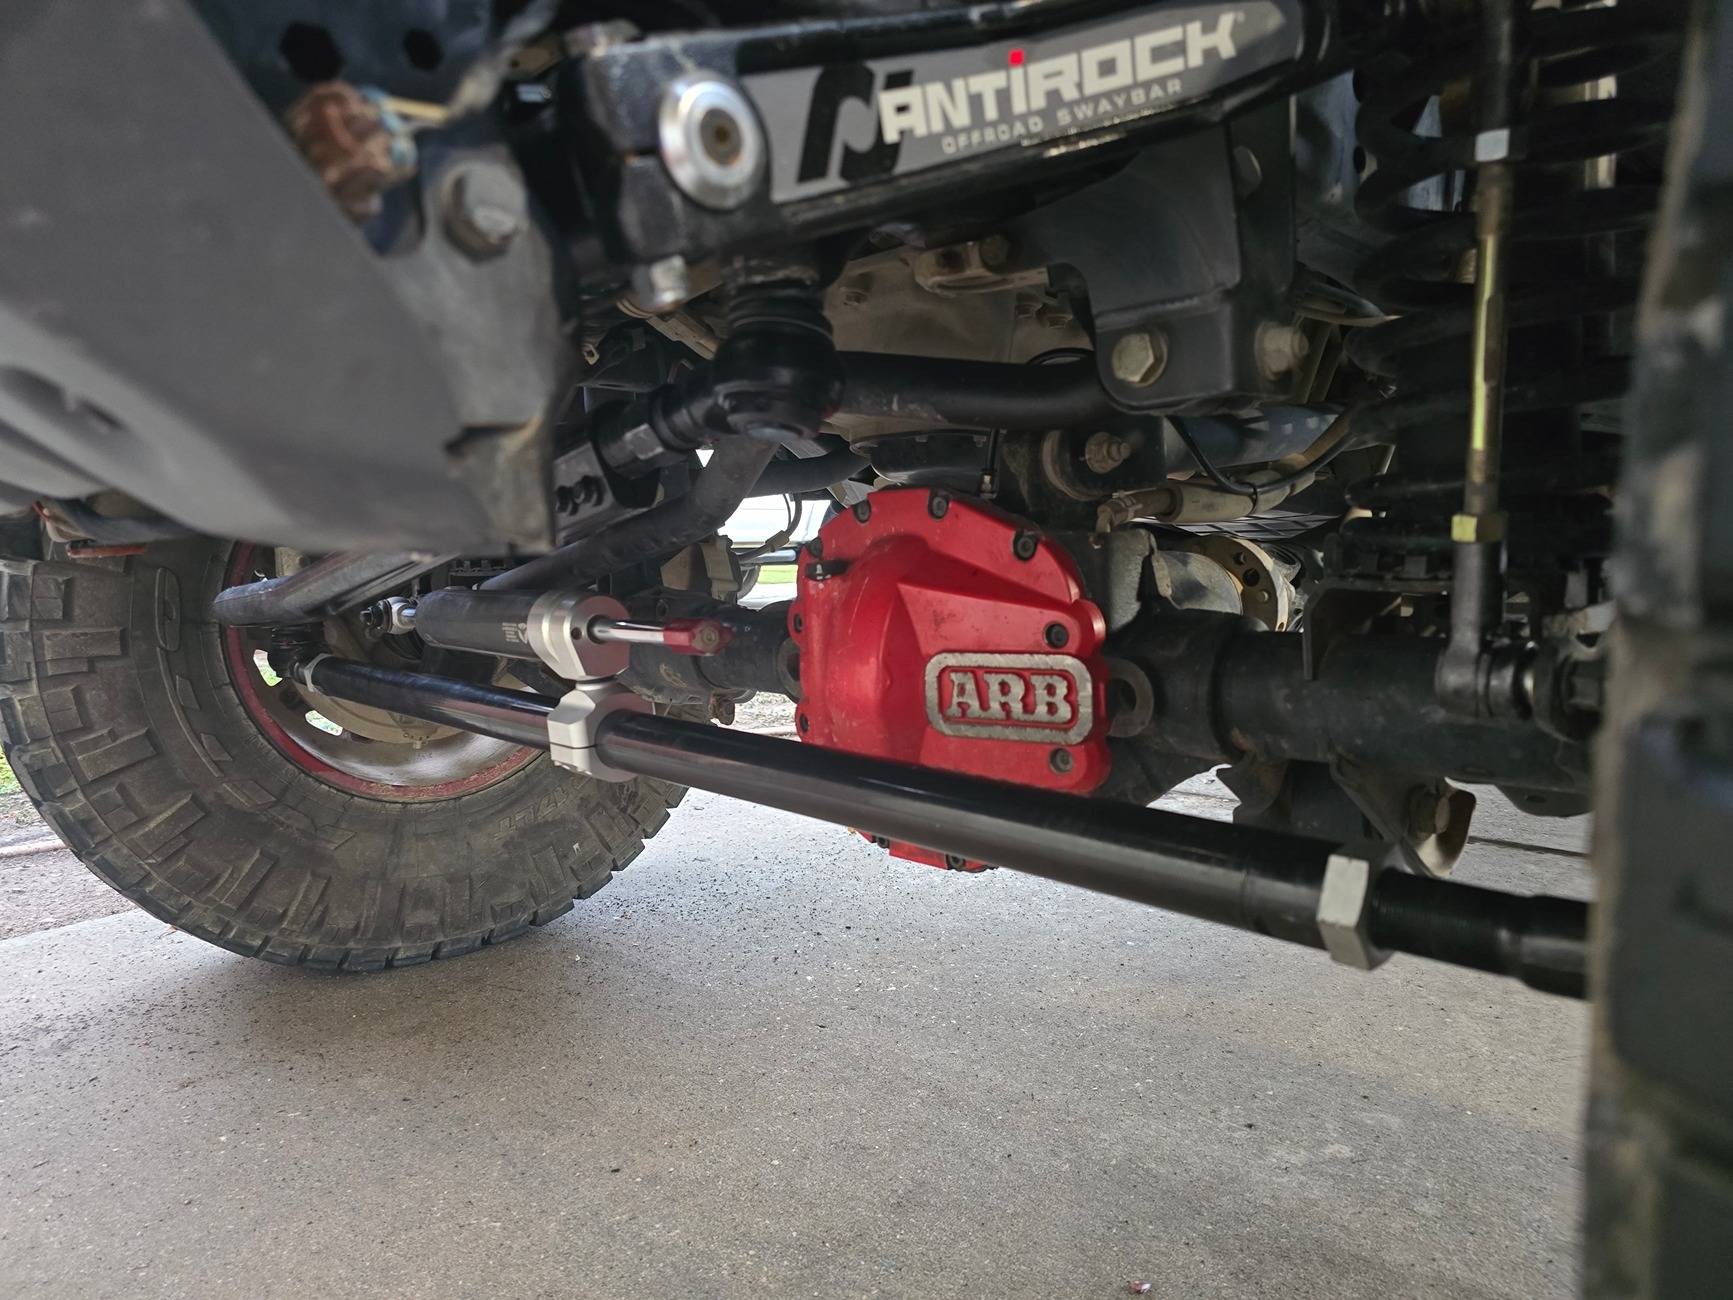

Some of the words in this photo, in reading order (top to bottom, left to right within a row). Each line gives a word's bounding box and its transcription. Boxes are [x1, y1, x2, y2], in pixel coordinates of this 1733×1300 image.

[942, 116, 1044, 154] OFFROAD
[1059, 79, 1183, 126] SWAYBAR
[945, 672, 1073, 724] ARB
